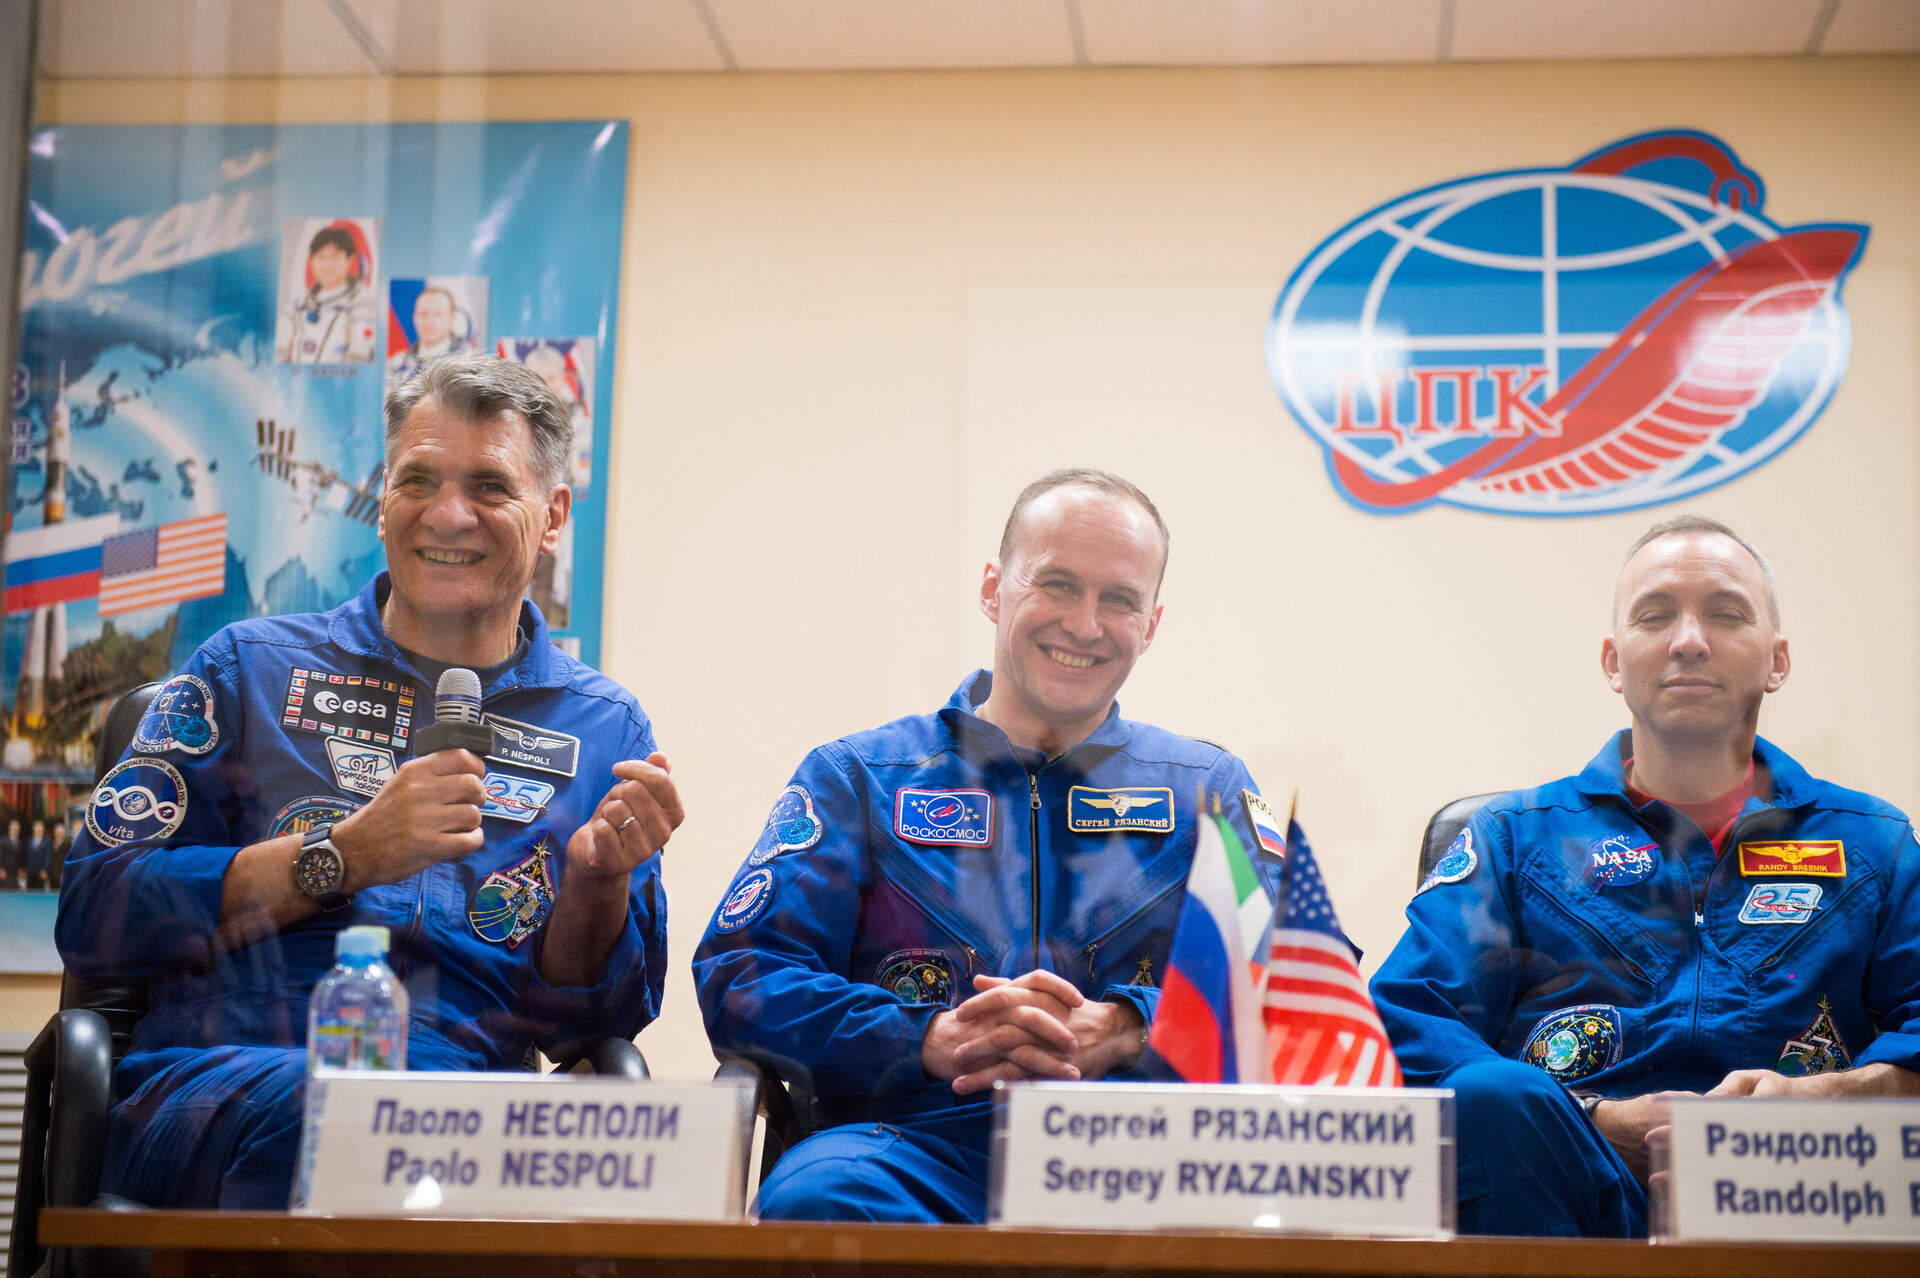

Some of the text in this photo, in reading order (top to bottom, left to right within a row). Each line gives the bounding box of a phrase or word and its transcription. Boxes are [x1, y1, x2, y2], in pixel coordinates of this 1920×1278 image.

[1331, 366, 1562, 446] ЦПК
[342, 699, 387, 719] esa
[501, 747, 551, 766] P. NESPOLI
[109, 825, 135, 839] vita
[902, 823, 986, 840] РОСКОСМОС
[1075, 818, 1168, 828] СЕРГЕЙ РЯЗАНСКИЙ
[1592, 850, 1653, 868] NASA
[1792, 864, 1828, 872] BRESNIK
[371, 1099, 682, 1140] Паоло НЕСПОЛИ
[1043, 1105, 1417, 1146] Сергей РЯЗАНСКИЙ
[1705, 1123, 1878, 1168] Рэндолф
[383, 1149, 655, 1190] Paolo NESPOLI
[1044, 1158, 1413, 1202] Sergey RYAZANSKIY
[1713, 1178, 1886, 1225] Randolph
